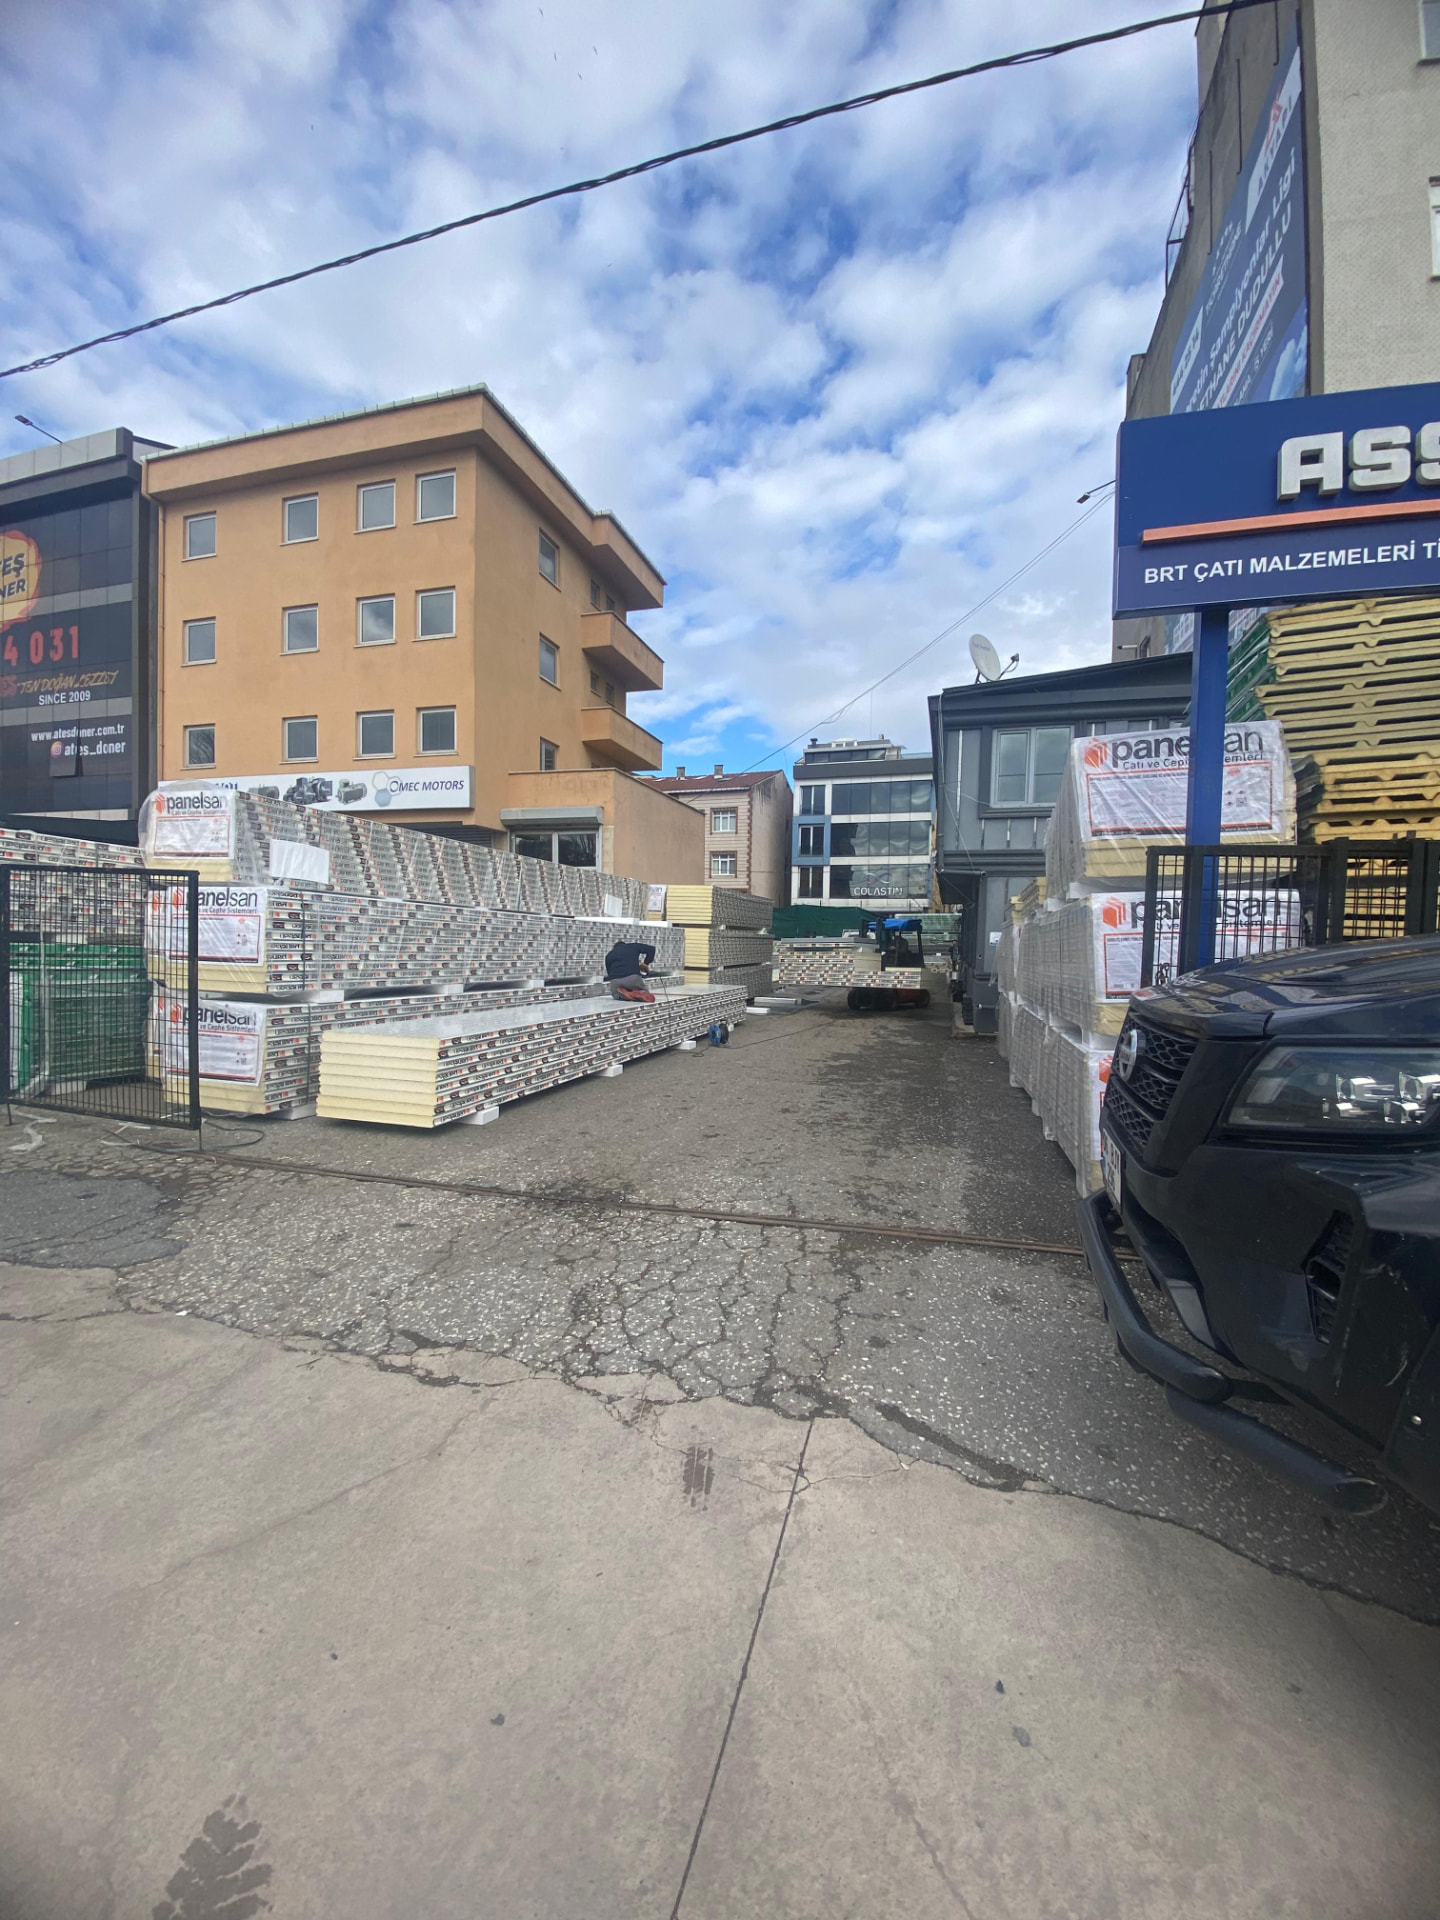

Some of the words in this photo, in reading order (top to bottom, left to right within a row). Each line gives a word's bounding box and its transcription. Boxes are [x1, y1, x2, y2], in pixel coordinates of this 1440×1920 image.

[1210, 215, 1270, 370] Şampiyonlar
[1273, 147, 1295, 219] Ligi
[1197, 331, 1236, 411] ETHANE
[1238, 200, 1291, 339] DUDULLU
[0, 553, 25, 578] EŞ
[1144, 565, 1188, 584] BRT
[1194, 559, 1243, 583] ÇATI
[1250, 540, 1416, 574] MALZEMELERİ
[30, 625, 79, 665] 031
[38, 692, 67, 706] SINCE
[68, 690, 92, 703] 2009
[64, 740, 127, 756] ates_doner
[1112, 730, 1264, 769] panean
[1148, 761, 1160, 769] ve
[389, 780, 420, 793] OMEC
[421, 780, 465, 792] MOTORS
[166, 791, 228, 815] panelsan
[186, 887, 258, 912] anelsan
[853, 887, 903, 896] COLASTIN
